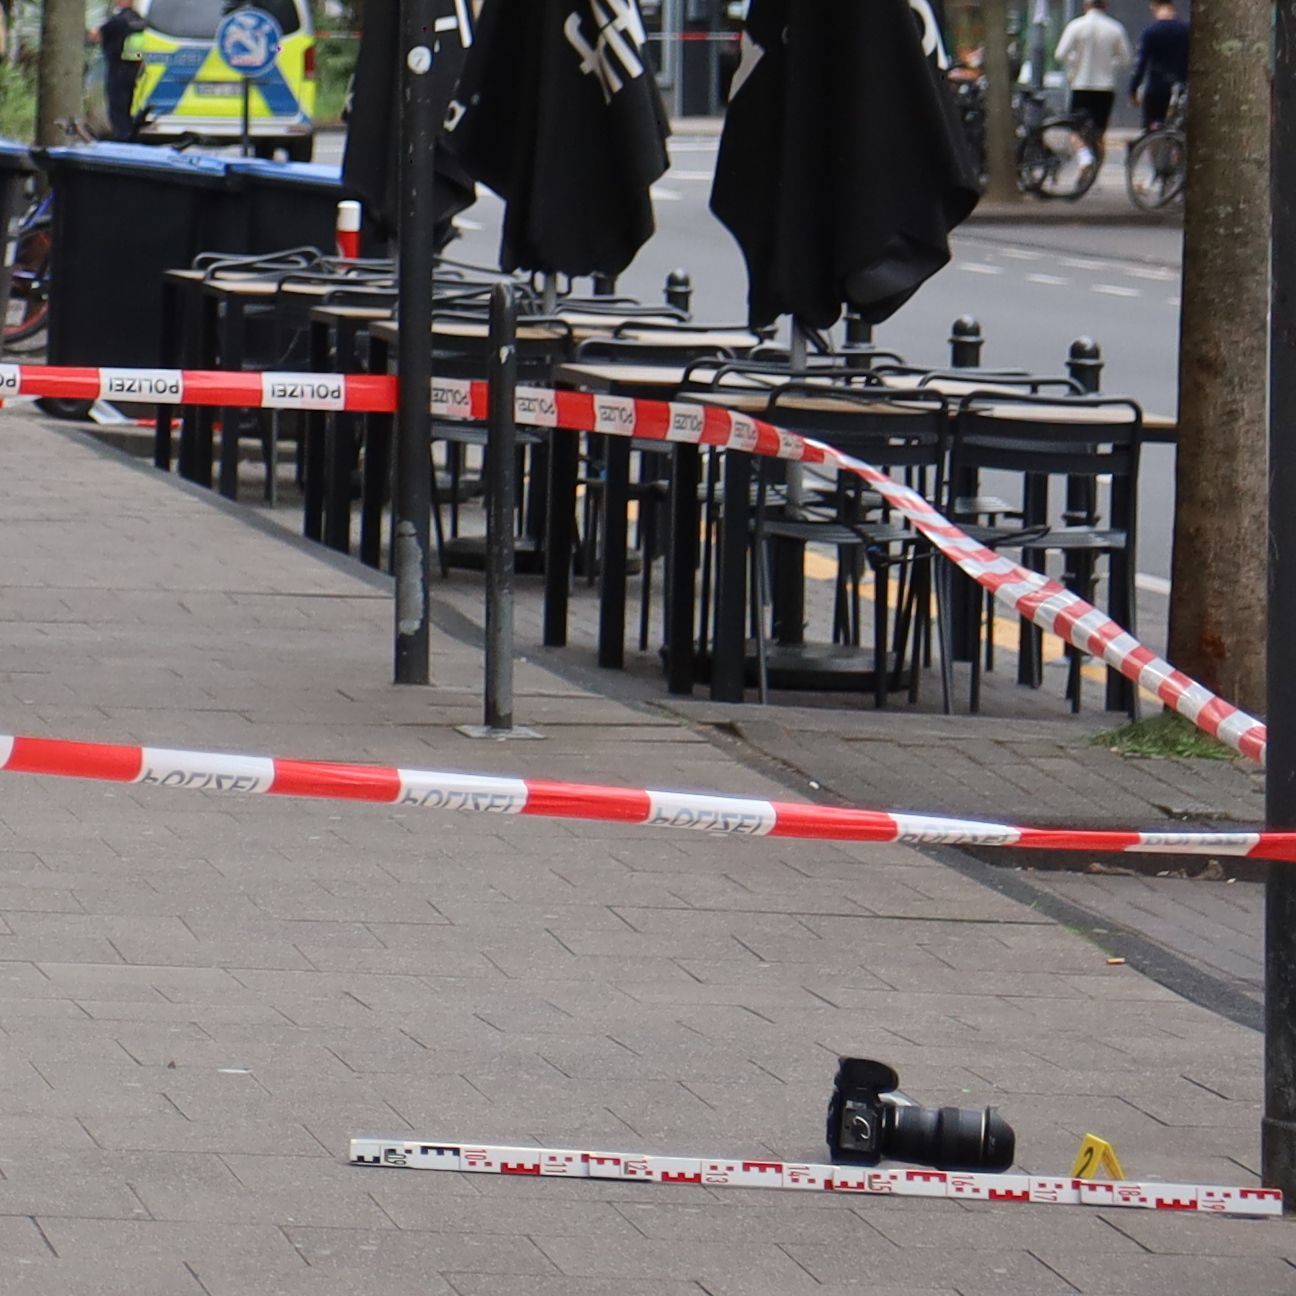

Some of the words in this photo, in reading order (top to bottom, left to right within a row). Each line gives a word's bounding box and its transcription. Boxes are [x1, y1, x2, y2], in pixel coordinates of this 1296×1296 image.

[108, 377, 179, 395] POLIZEI
[271, 381, 341, 400] POLIZEI
[1075, 1147, 1094, 1179] 2
